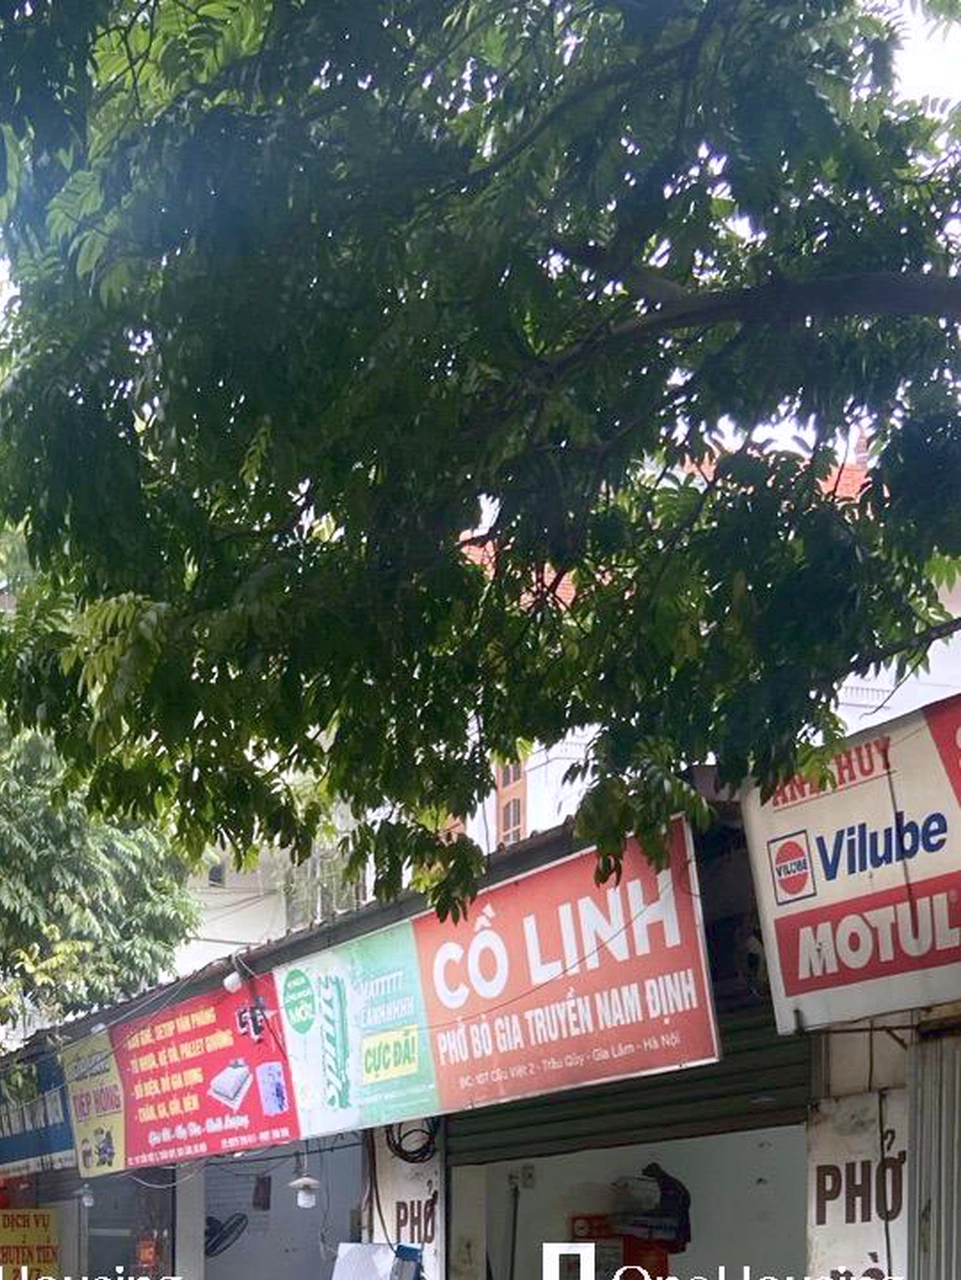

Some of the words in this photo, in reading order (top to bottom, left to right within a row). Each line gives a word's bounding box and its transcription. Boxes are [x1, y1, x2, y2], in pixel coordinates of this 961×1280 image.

[834, 736, 891, 786] HUY
[816, 810, 948, 882] Vilube
[433, 904, 510, 1010] CỒ
[522, 867, 681, 987] LINH
[799, 891, 960, 981] MOTUL
[495, 1013, 524, 1053] GIA
[525, 986, 594, 1046] TRUYỀN
[596, 982, 643, 1030] NAM
[645, 968, 698, 1025] ĐỊNH
[397, 1179, 438, 1244] PHỞ
[815, 1129, 907, 1226] PHỞ
[1, 1214, 30, 1232] DỊCH
